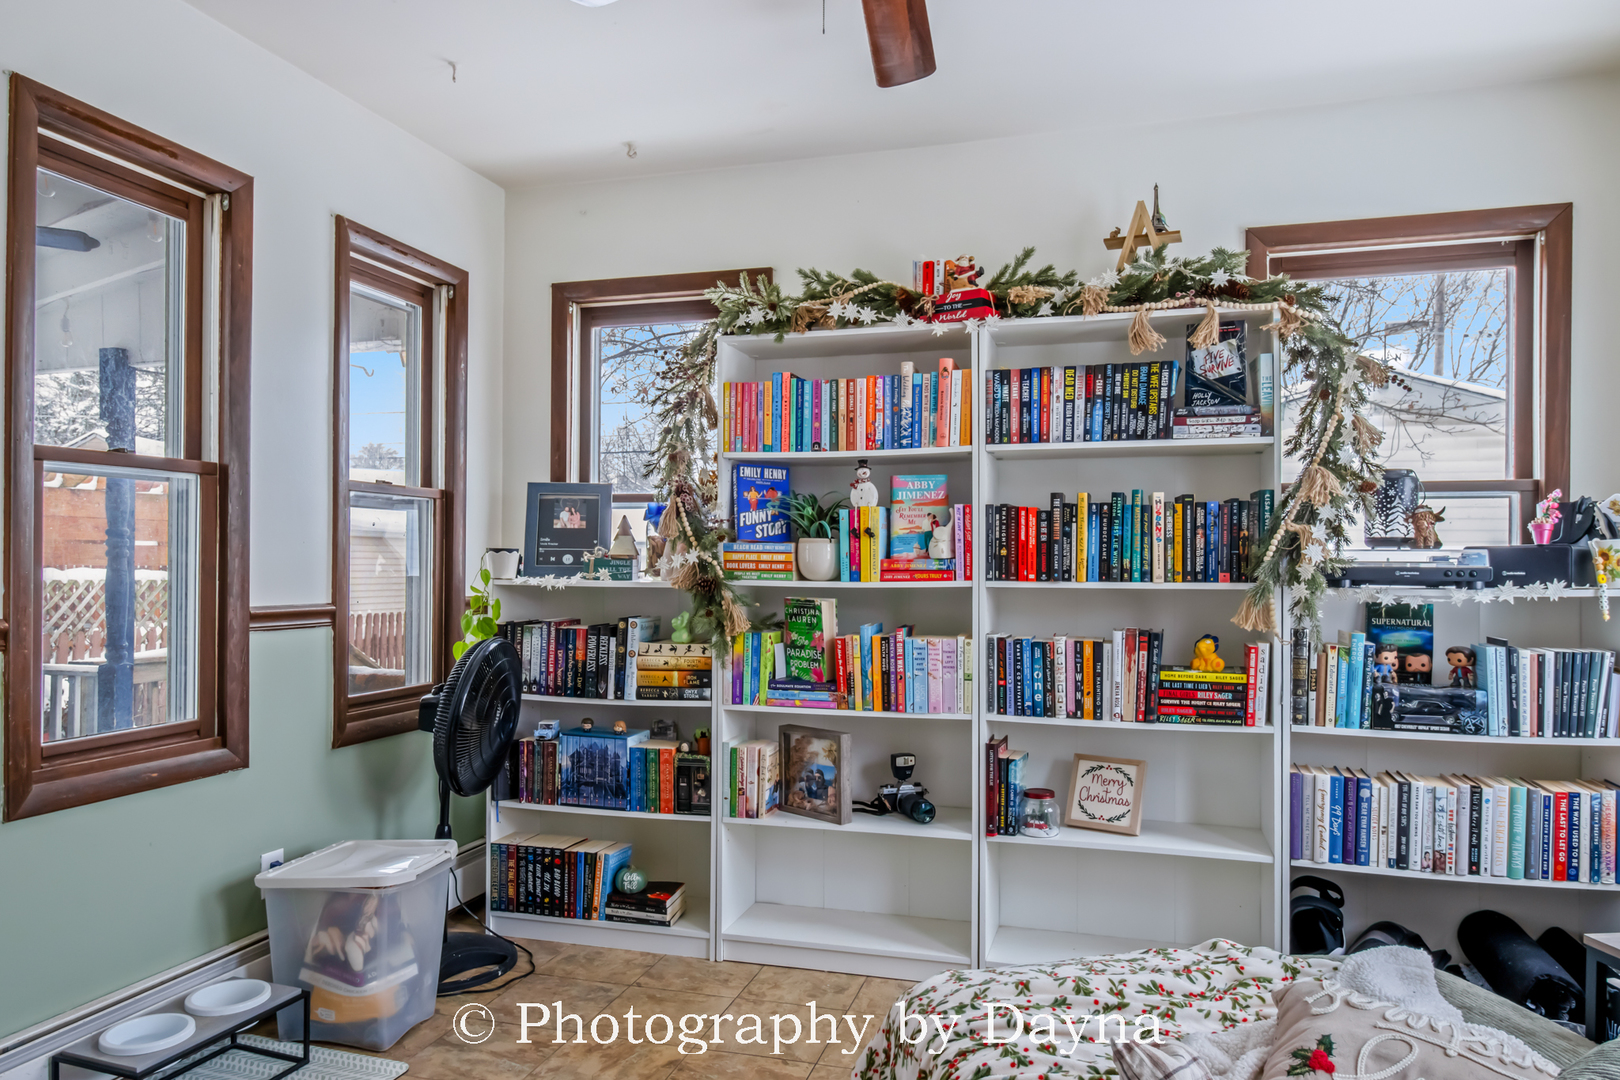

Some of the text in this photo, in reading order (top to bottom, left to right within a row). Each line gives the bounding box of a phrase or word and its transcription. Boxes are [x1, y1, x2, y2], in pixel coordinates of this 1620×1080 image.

[946, 292, 961, 303] Joy
[939, 311, 967, 321] World
[1204, 349, 1224, 364] FIVE
[1200, 356, 1234, 376] SURVIVE
[1066, 369, 1074, 385] DEAD
[1138, 366, 1148, 405] BRAIN DAMAGE
[1149, 363, 1160, 415] THE WIFE UPSTAIRS
[1065, 387, 1074, 400] MED
[1191, 398, 1220, 406] JACKSON
[740, 466, 786, 480] EMILY HENRY
[907, 481, 936, 489] ABBY
[897, 490, 945, 500] JIMENEZ
[740, 509, 772, 526] FUNNY
[755, 521, 787, 538] STORY
[785, 607, 820, 615] CHRISTINA
[1372, 618, 1432, 627] SUPERNATURAL
[587, 635, 596, 672] POWERLESS
[599, 635, 609, 666] RECKLESS
[787, 648, 822, 659] PARADISE
[790, 660, 819, 669] PROBLEM
[1092, 773, 1127, 796] Merry
[1079, 786, 1131, 806] Christmas
[1317, 789, 1328, 823] Emergency
[1330, 804, 1342, 836] 99 Days
[1512, 804, 1522, 833] OPPOSITE
[1560, 829, 1566, 837] TO
[1511, 842, 1521, 868] ALWAYS
[1559, 852, 1565, 862] GO
[1572, 848, 1578, 857] TO
